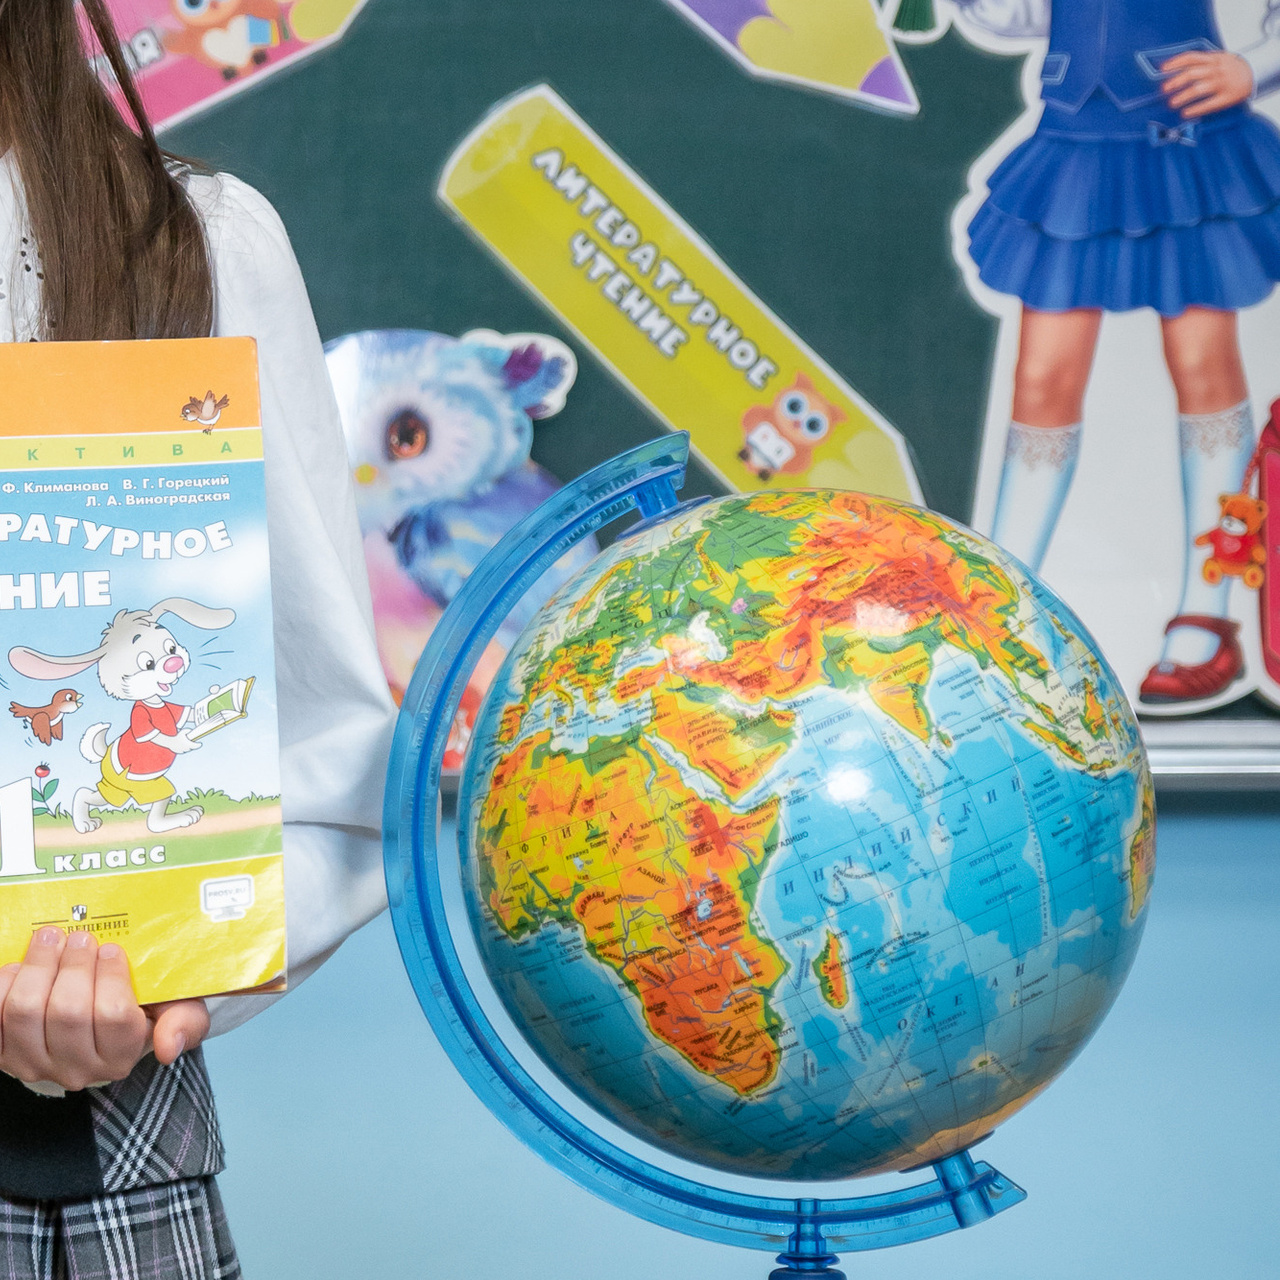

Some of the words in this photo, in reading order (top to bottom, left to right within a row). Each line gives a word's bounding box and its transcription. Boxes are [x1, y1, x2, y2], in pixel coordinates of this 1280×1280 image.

[530, 146, 780, 392] ЛИТЕРАТУРНОЕ
[569, 229, 690, 360] ЧТЕНИЕ
[1, 482, 20, 494] Ф.
[23, 481, 110, 494] Климанова
[122, 479, 137, 490] В.
[142, 478, 155, 489] Г.
[158, 474, 230, 490] Горецкий
[85, 495, 101, 507] Л.
[106, 494, 122, 506] А.
[125, 491, 231, 508] Виноградская
[763, 830, 810, 855] МОГАДИШО
[52, 844, 166, 874] класс
[636, 866, 669, 886] АЗАНДЕ
